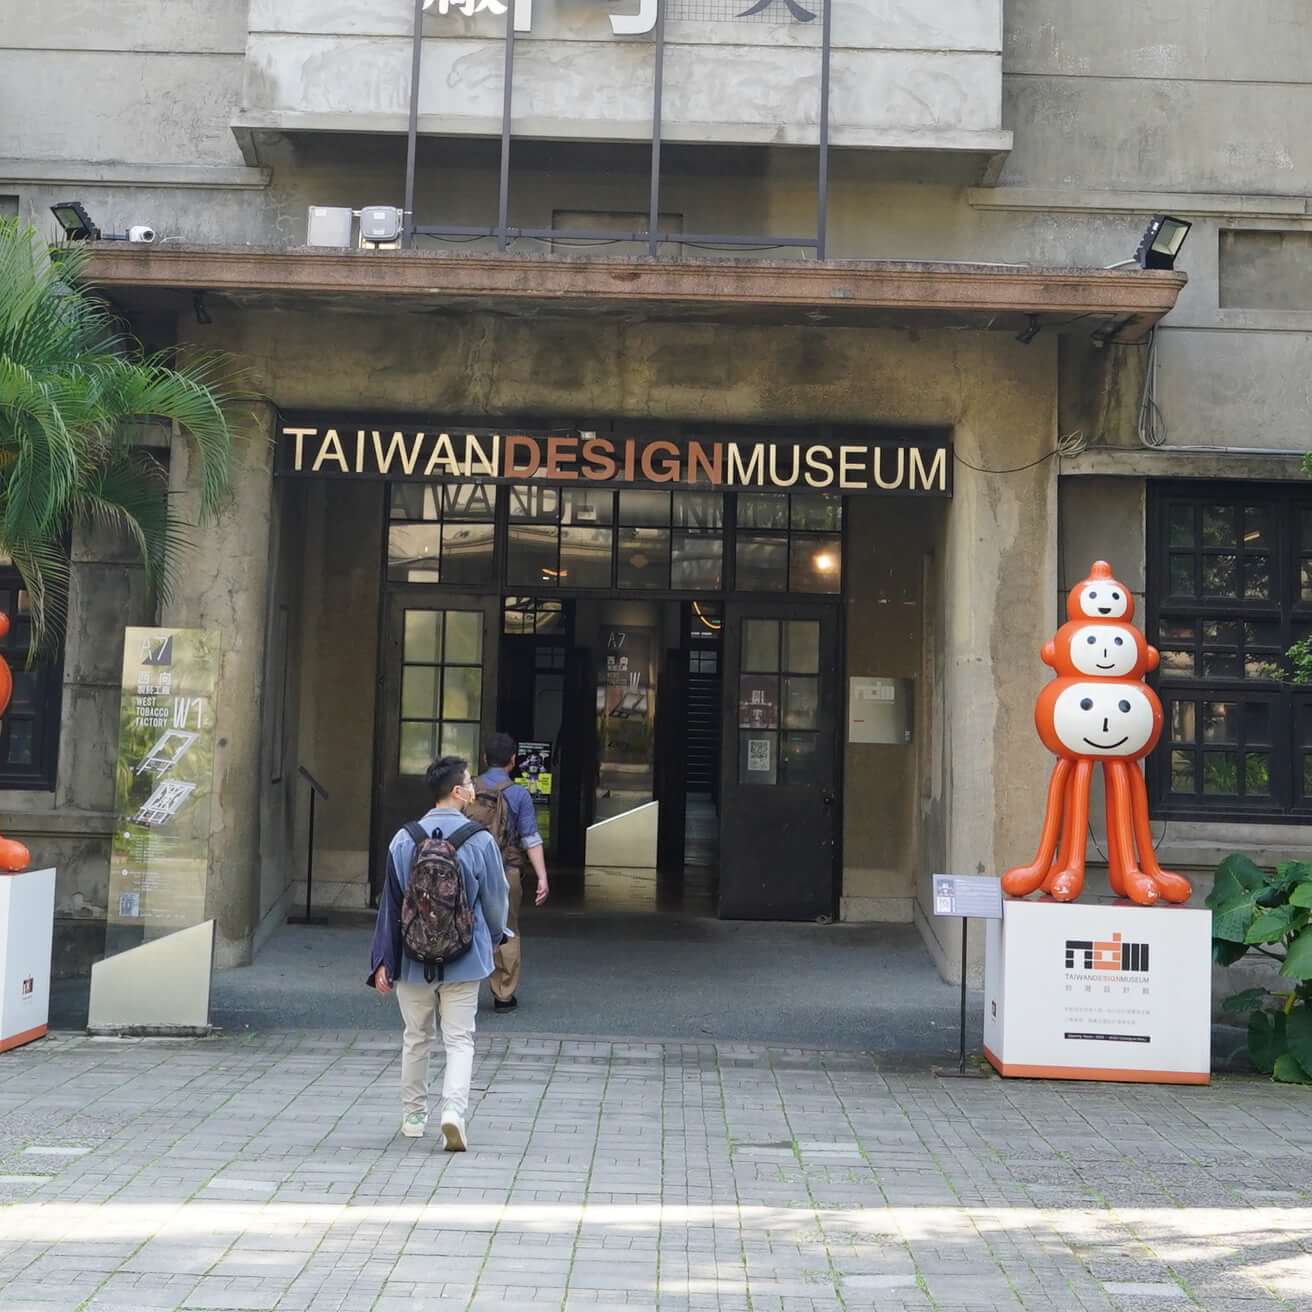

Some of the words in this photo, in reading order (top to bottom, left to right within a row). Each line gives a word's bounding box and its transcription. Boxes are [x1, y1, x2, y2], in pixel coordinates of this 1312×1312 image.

[136, 696, 156, 706] WEST
[136, 706, 169, 717] TOBACCO
[173, 696, 202, 729] W1
[135, 717, 168, 727] FACTORY
